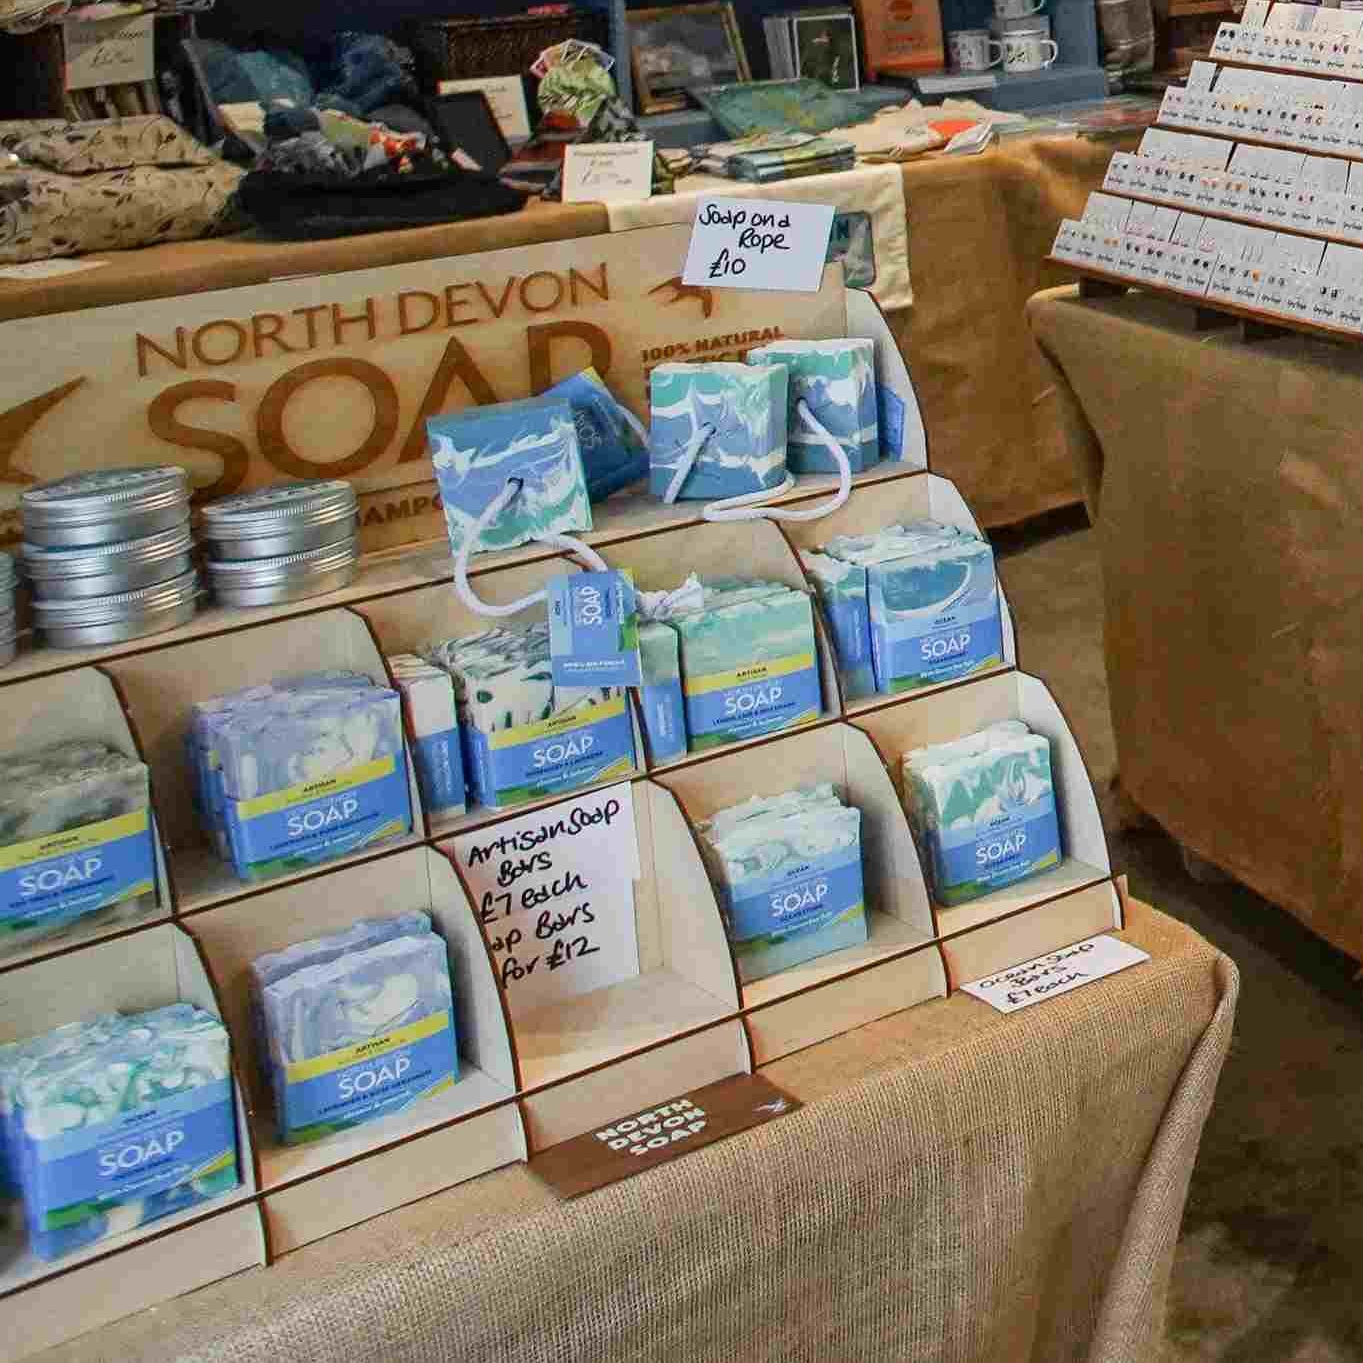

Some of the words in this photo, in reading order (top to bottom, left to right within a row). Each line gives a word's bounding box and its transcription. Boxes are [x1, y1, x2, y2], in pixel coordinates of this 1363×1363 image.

[699, 204, 746, 229] Soap
[751, 213, 775, 228] on
[778, 214, 791, 228] a
[738, 228, 791, 254] Rope
[708, 248, 747, 278] £10
[135, 298, 377, 376] NORTH
[397, 262, 610, 336] DEVON
[642, 342, 690, 362] 100%
[695, 326, 784, 352] NATURAL
[147, 320, 612, 500] SOAP
[581, 585, 602, 626] SOAP
[921, 634, 971, 660] SOAP
[725, 686, 782, 718] SOAP
[533, 736, 594, 768] SOAP
[287, 799, 358, 836] SOAP
[468, 820, 566, 868] Artisan
[567, 799, 620, 835] Soap
[975, 834, 1026, 864] SOAP
[18, 856, 103, 897] SOAP
[497, 851, 553, 887] Bars
[480, 891, 512, 925] £7
[521, 871, 588, 910] each
[771, 883, 828, 917] SOAP
[536, 902, 595, 939] Bars
[501, 956, 540, 989] for
[547, 936, 601, 970] £12
[338, 1057, 411, 1099] SOAP
[595, 1099, 694, 1141] NORTH
[607, 1108, 706, 1151] DEVON
[629, 1120, 707, 1156] SOAP
[98, 1130, 185, 1176] SOAP
